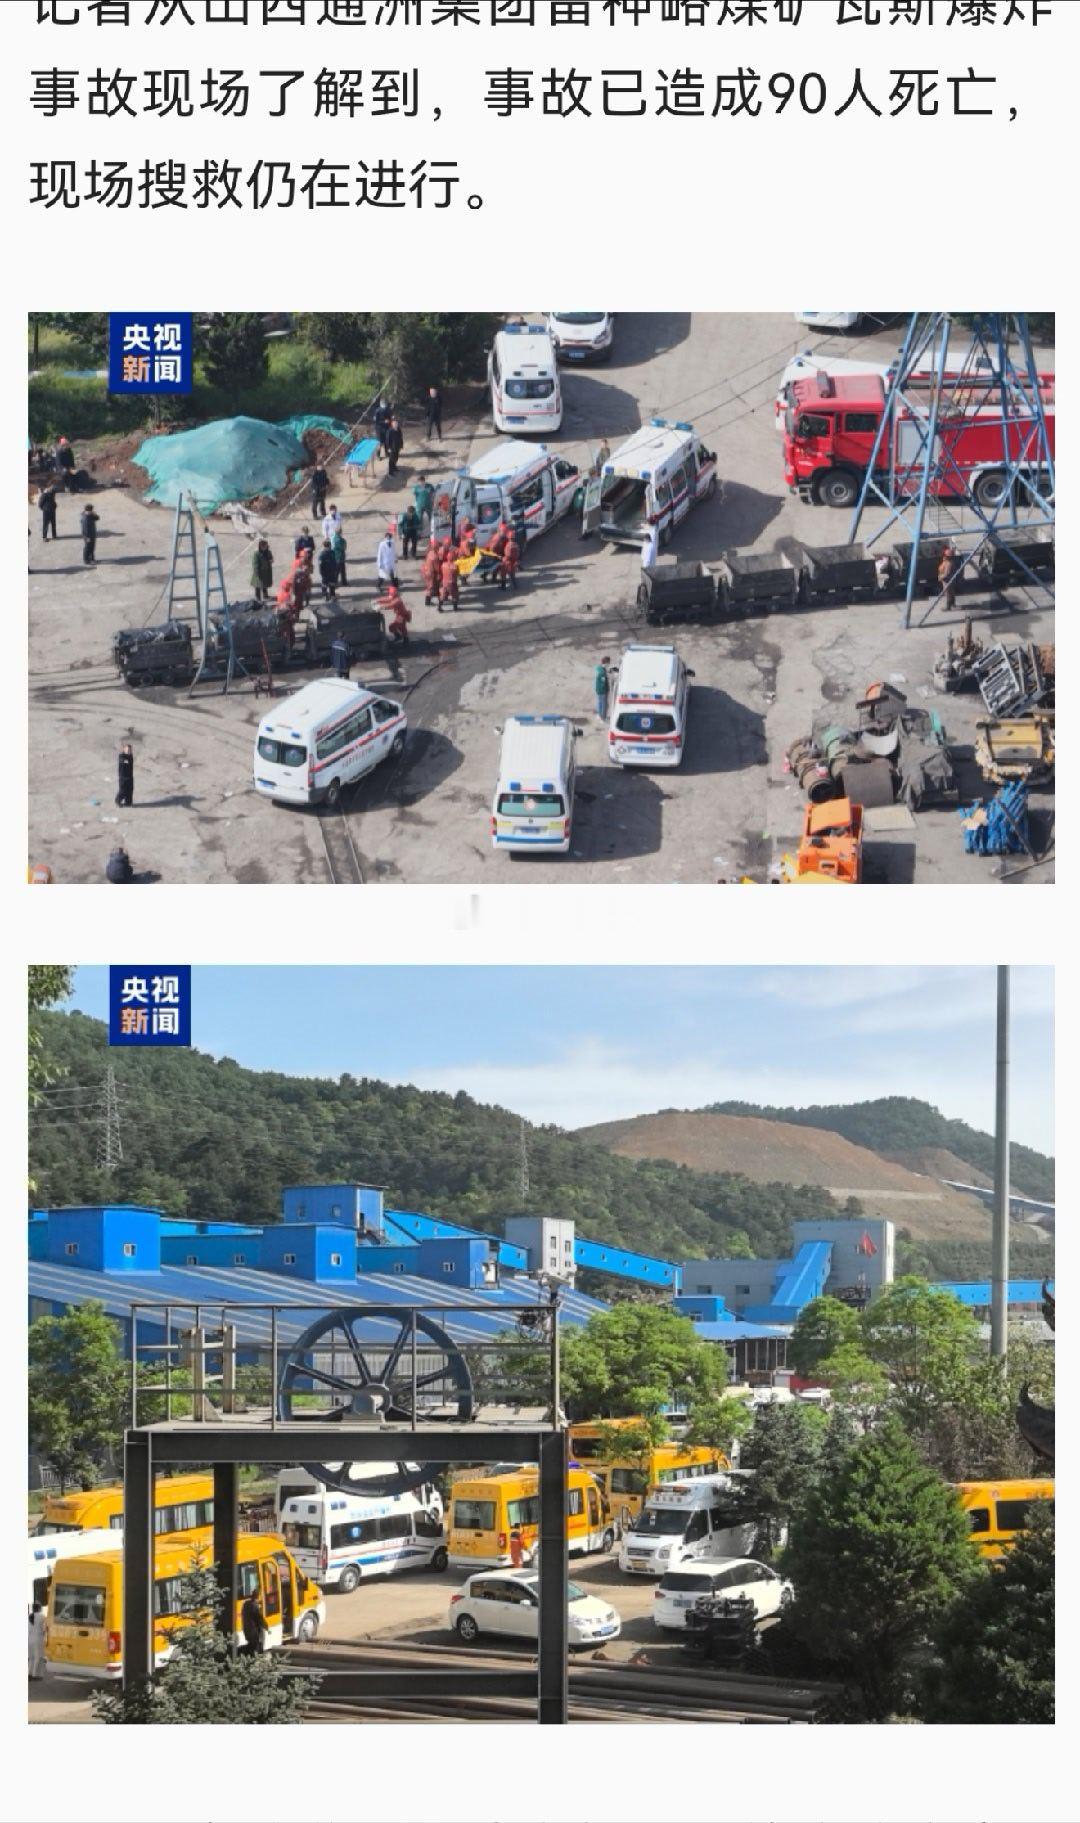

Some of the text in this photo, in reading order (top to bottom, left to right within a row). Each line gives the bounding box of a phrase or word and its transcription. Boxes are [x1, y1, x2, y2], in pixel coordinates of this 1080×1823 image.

[29, 67, 1018, 122] 事故现场了解到，事故已造成90人死亡，
[29, 158, 484, 210] 现场搜救仍在进行。
